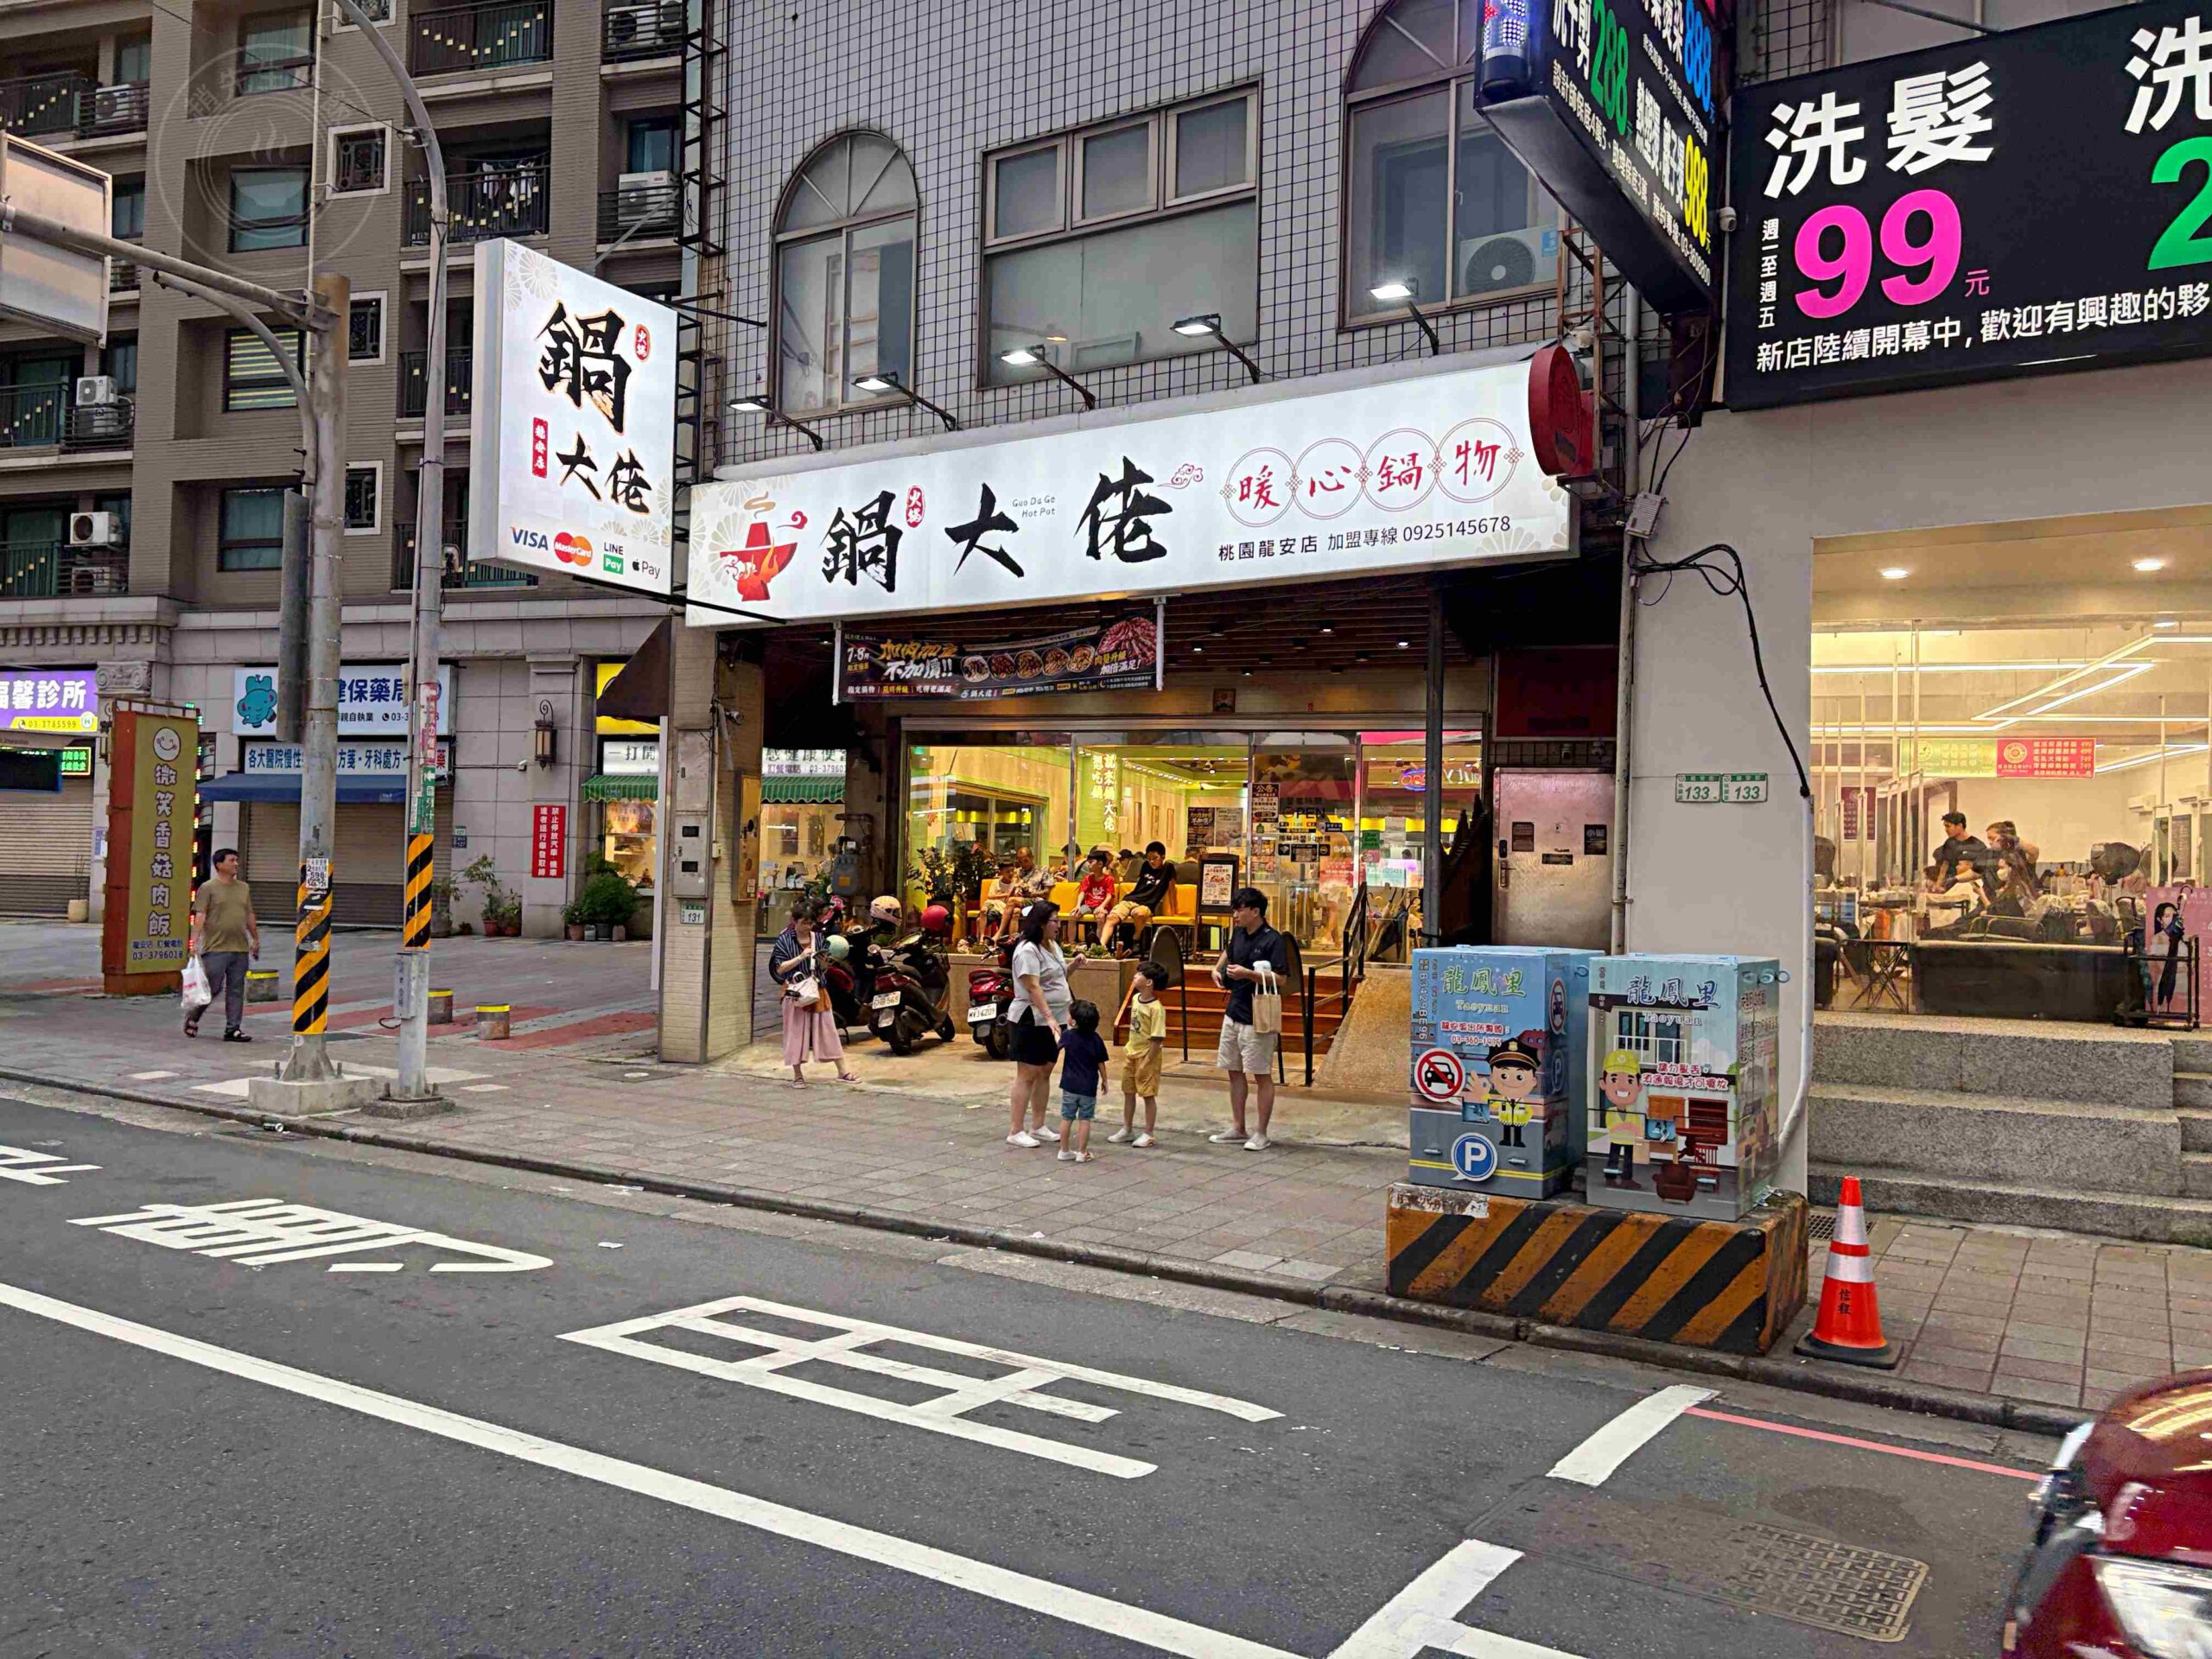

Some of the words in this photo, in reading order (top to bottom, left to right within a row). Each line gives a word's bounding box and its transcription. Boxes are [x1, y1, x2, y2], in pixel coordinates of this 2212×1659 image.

[1764, 60, 1994, 199] 洗髮
[1758, 218, 1779, 328] 週一至週五
[1012, 499, 1028, 507] Guo
[1030, 497, 1042, 505] Da
[1044, 495, 1056, 504] Ge
[1021, 509, 1038, 518] Hot
[1039, 507, 1056, 516] Pot
[511, 525, 549, 551] VISA
[1218, 535, 1319, 562] 桃園龍安店
[1327, 526, 1398, 551] 加盟專線
[1402, 516, 1511, 543] 0925145678
[554, 539, 592, 558] MasterCard
[603, 542, 624, 556] LINE
[605, 557, 623, 573] Pay
[640, 560, 661, 581] Pay
[336, 712, 374, 722] 親自執業
[1685, 785, 1711, 800] 133
[1735, 785, 1760, 800] 133
[147, 763, 177, 938] 微笑香菇肉飯
[688, 912, 701, 922] 131
[1442, 965, 1527, 998] 龍鳳里
[1627, 976, 1720, 1009] 龍鳳里
[1455, 1000, 1510, 1014] Taoyuan
[1643, 1012, 1702, 1027] Taoyuan
